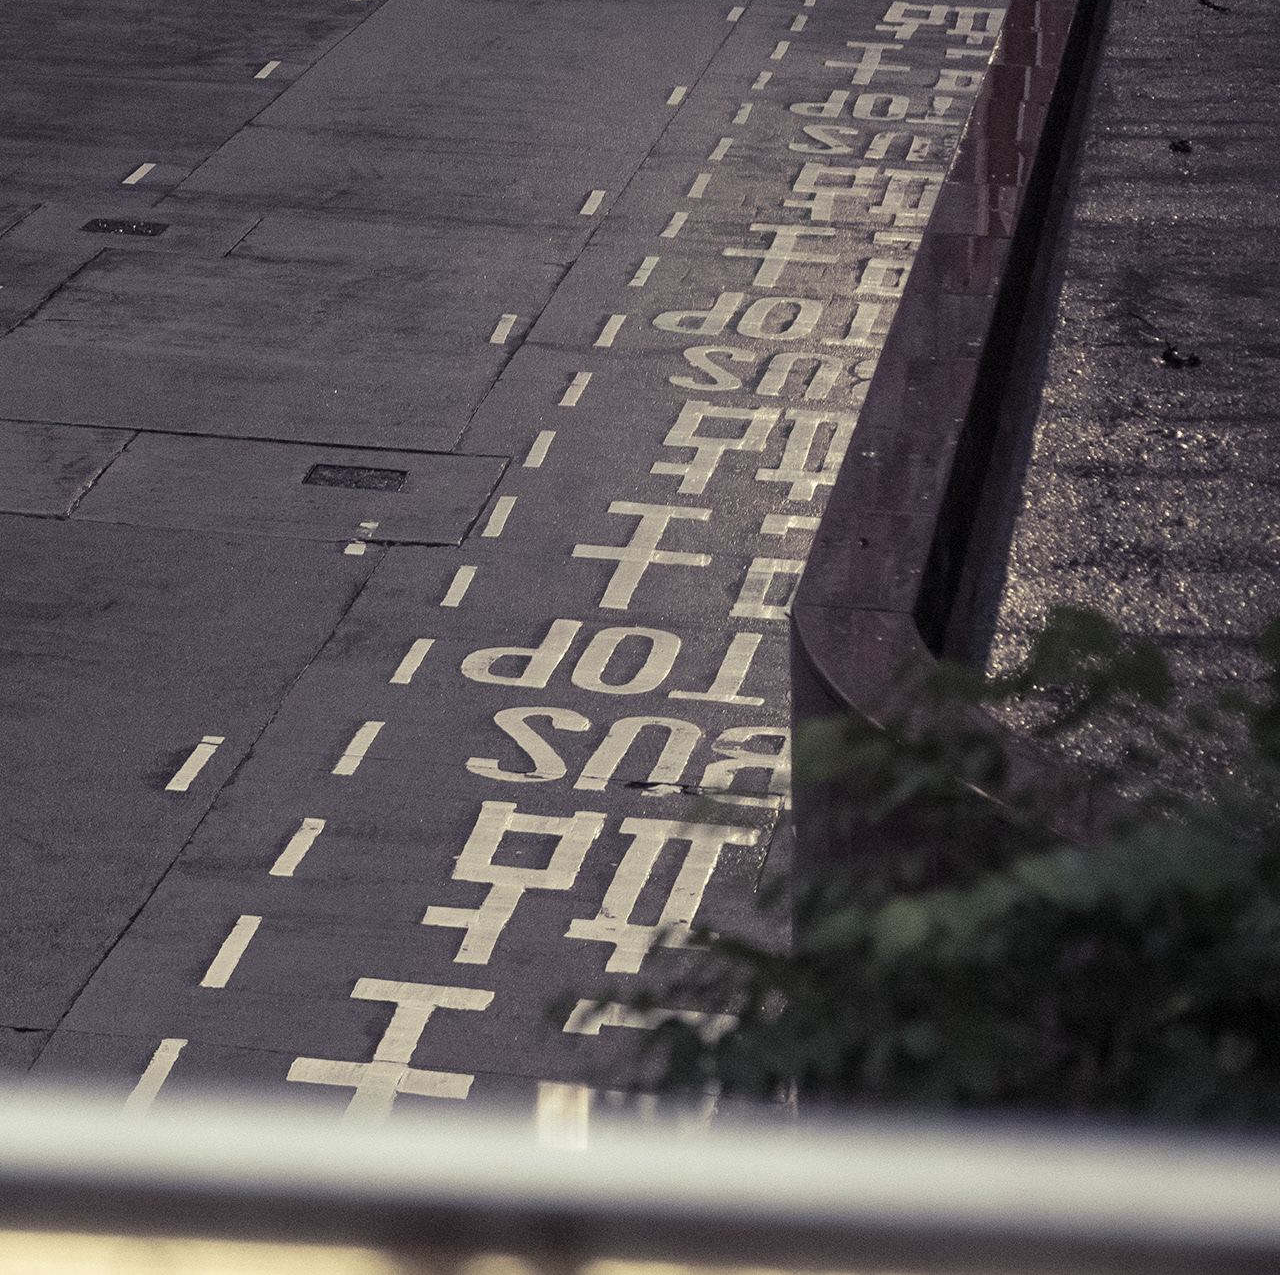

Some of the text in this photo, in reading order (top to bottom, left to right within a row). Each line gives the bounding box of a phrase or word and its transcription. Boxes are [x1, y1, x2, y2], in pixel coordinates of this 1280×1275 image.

[875, 1, 1007, 45] 站
[789, 89, 961, 126] TOP
[787, 125, 957, 162] US
[783, 162, 945, 227] 站
[652, 291, 882, 347] TOP
[649, 400, 860, 502] 站
[461, 618, 766, 707] TOP
[465, 705, 791, 810] BUS
[421, 800, 760, 974] 站
